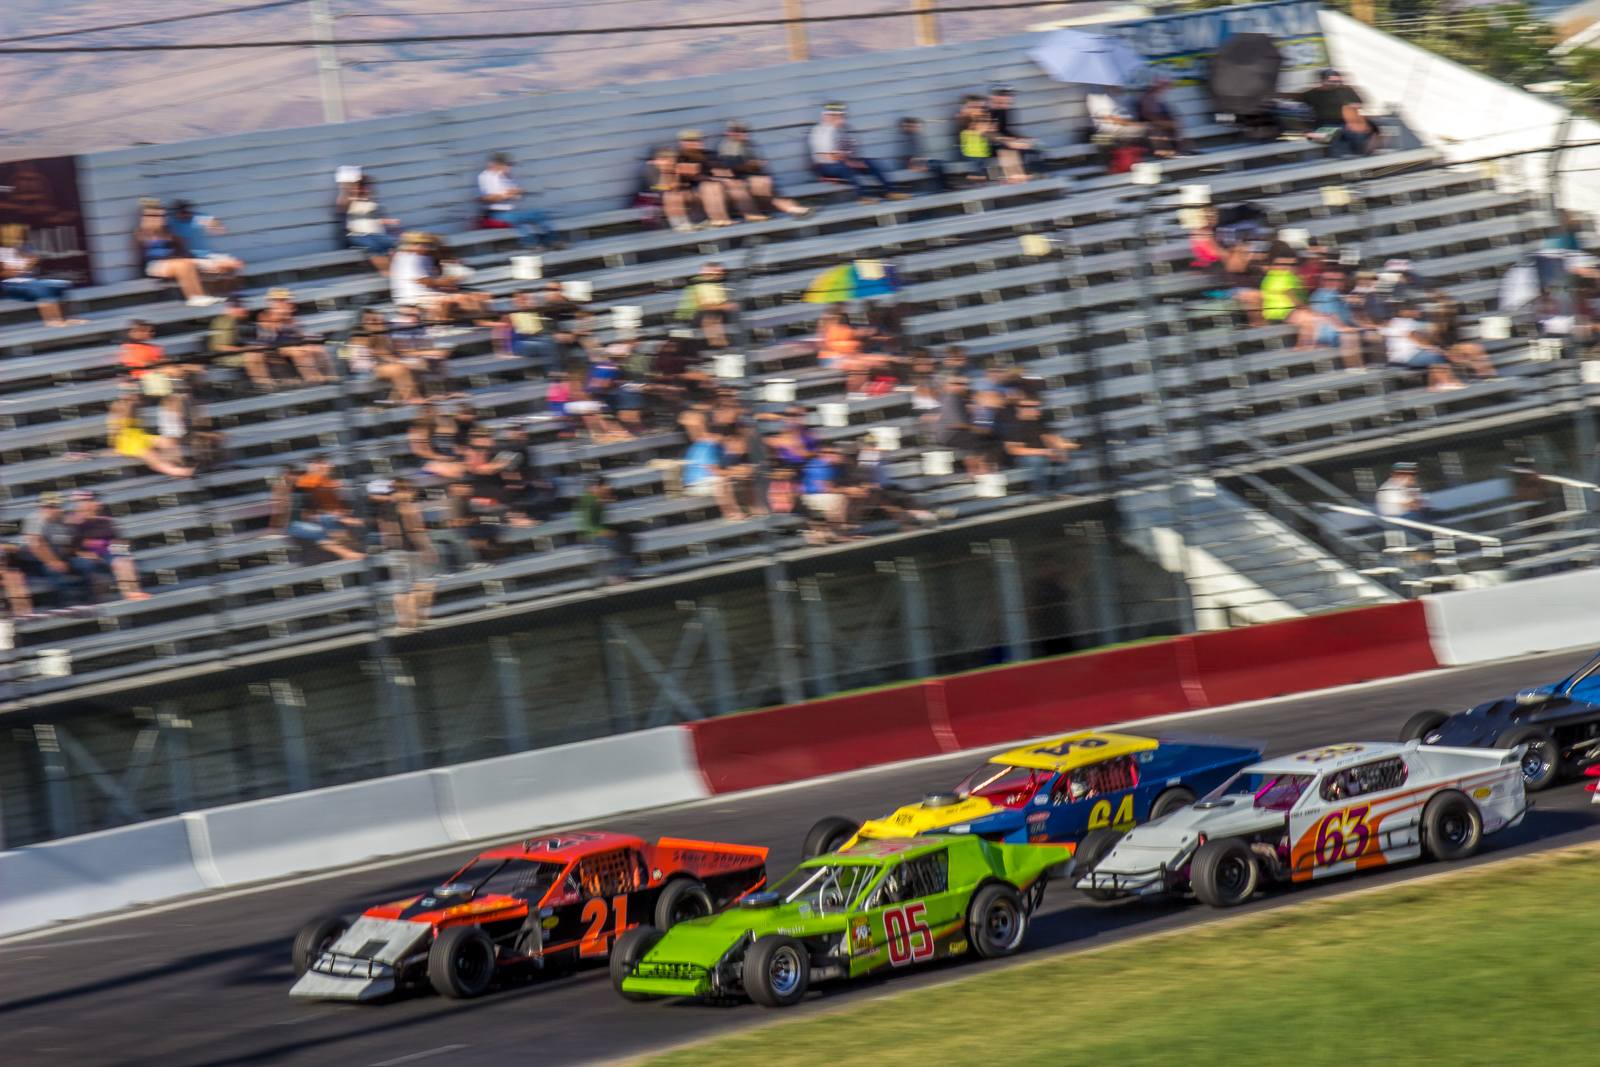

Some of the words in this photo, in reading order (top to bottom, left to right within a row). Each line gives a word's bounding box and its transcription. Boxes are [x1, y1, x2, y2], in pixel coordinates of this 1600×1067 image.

[1314, 801, 1372, 868] 63
[580, 894, 628, 958] 21
[883, 899, 935, 967] 05
